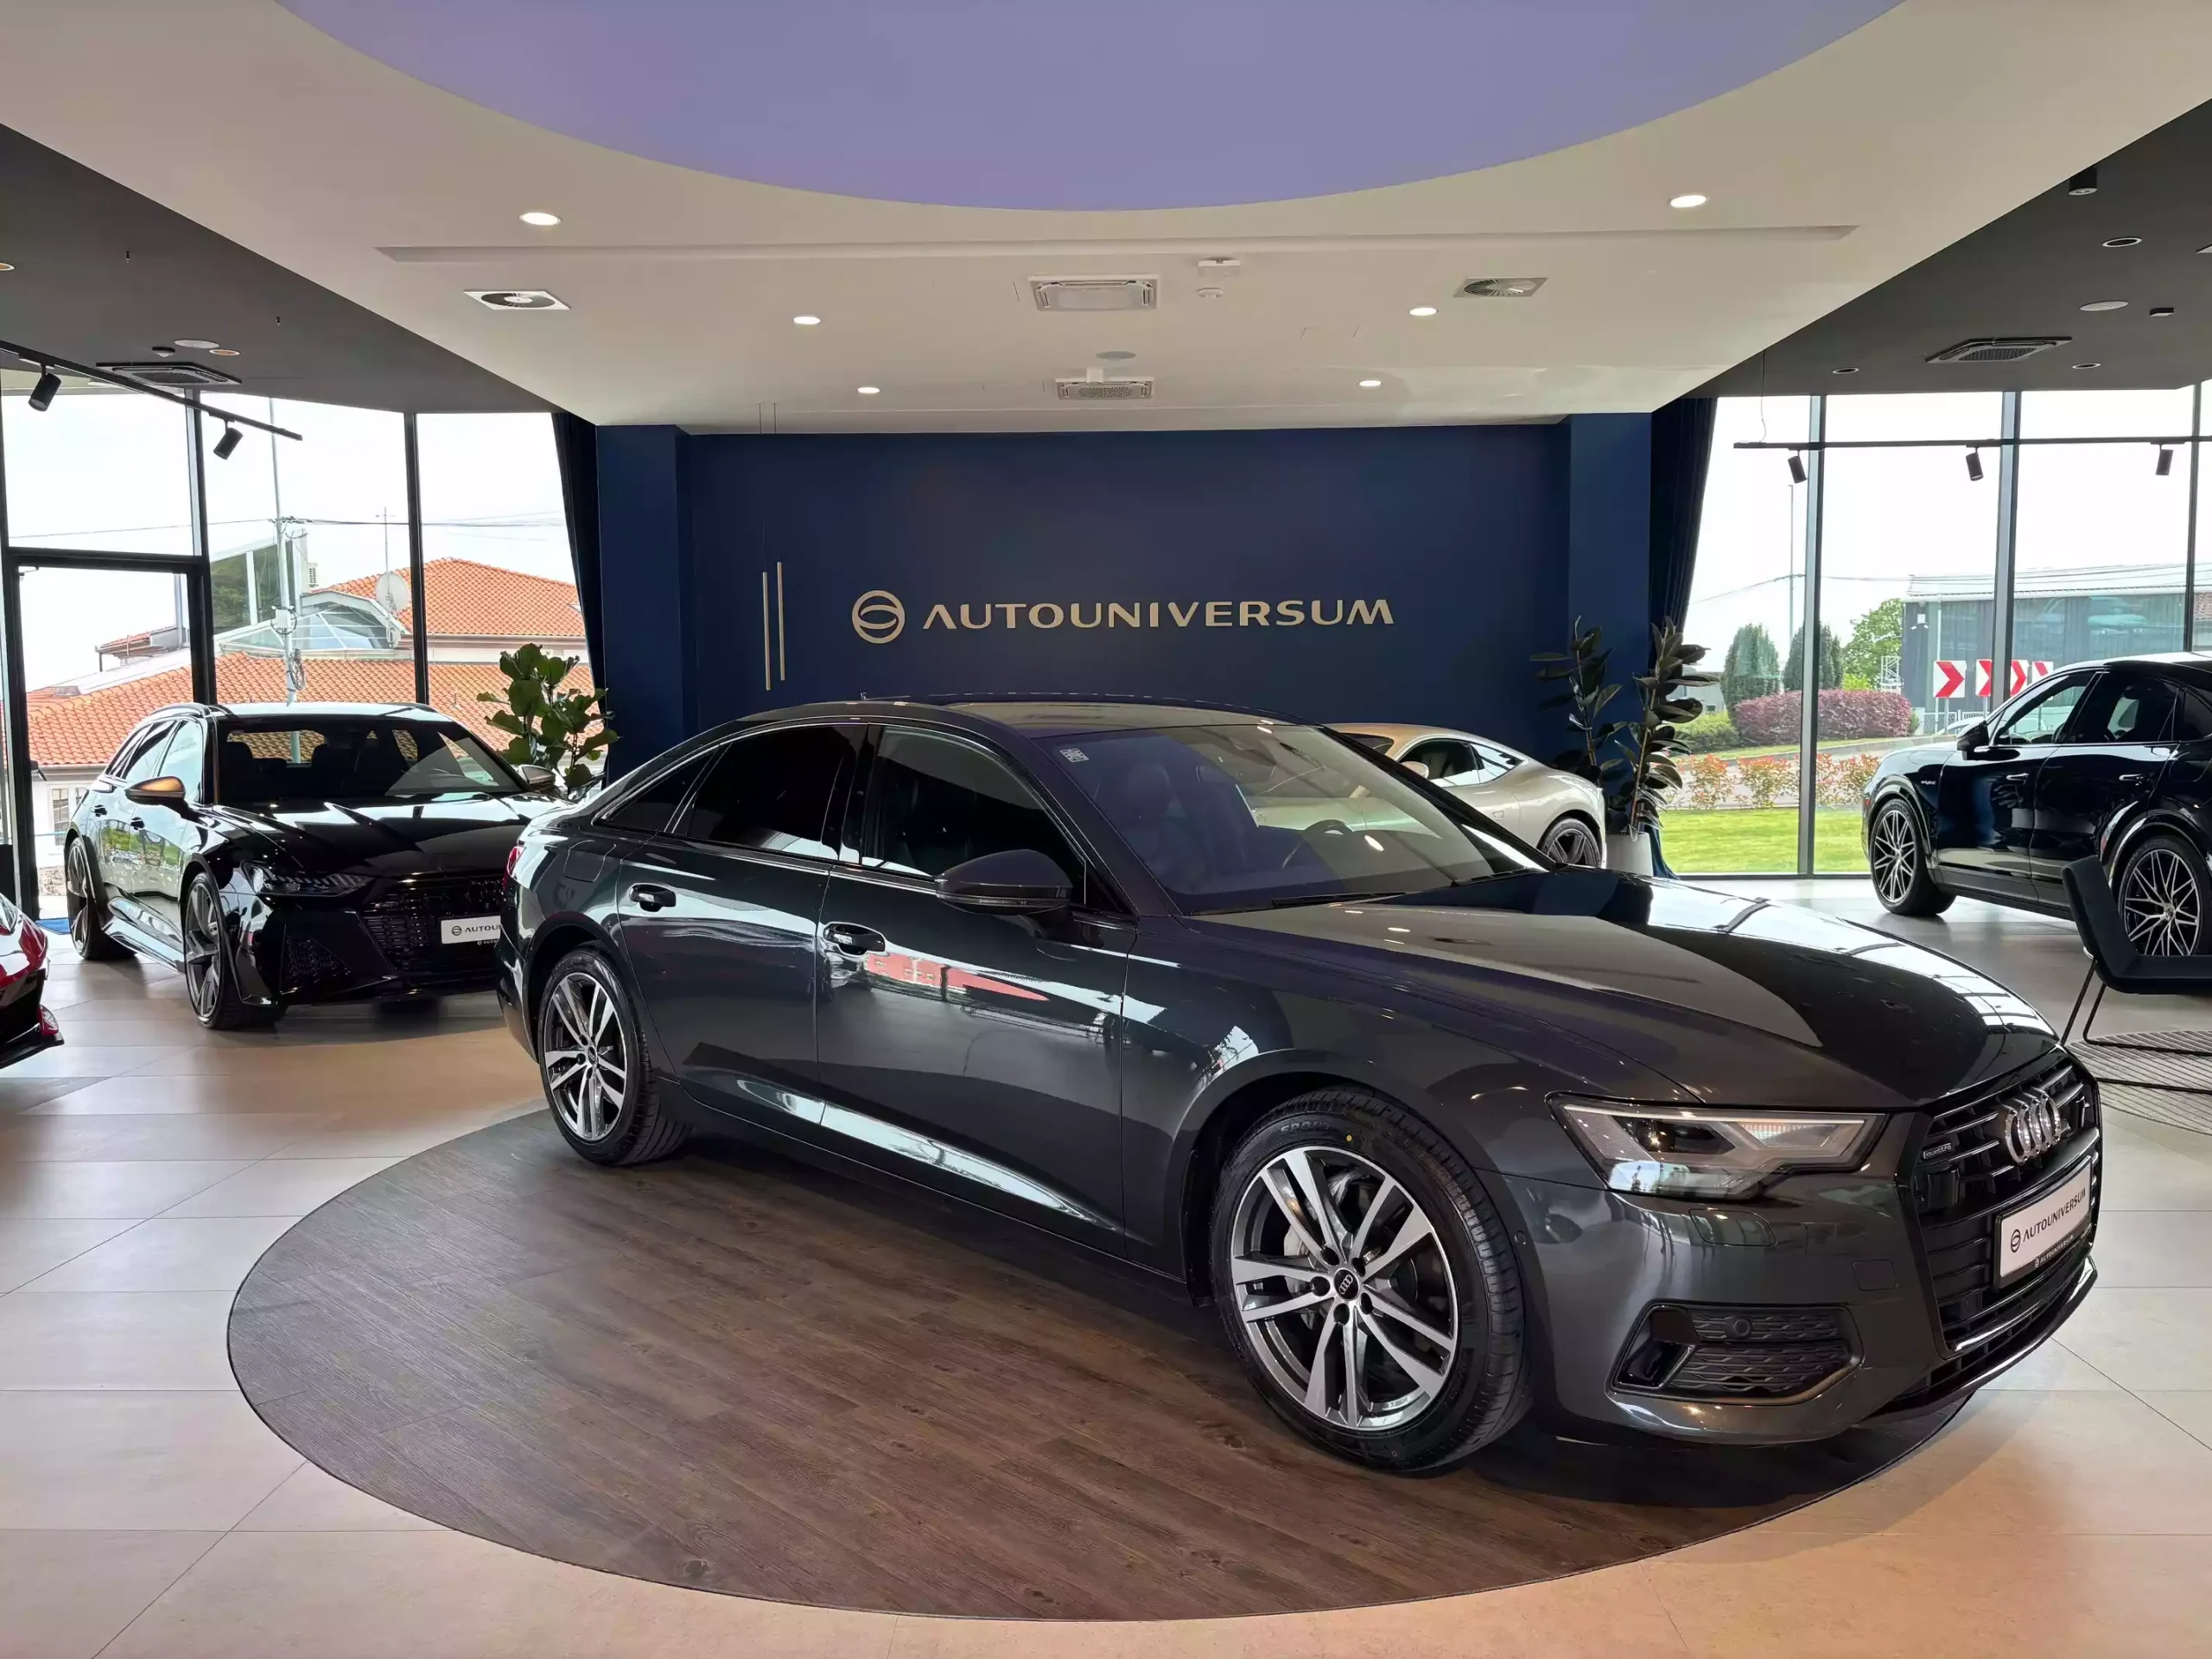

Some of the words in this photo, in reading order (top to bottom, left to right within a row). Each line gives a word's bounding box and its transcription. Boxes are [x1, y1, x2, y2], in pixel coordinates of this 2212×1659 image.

[922, 599, 1395, 629] AUTOUNIVERSUM
[1925, 1145, 1952, 1159] quattro
[2023, 1187, 2086, 1243] AUTOUNIVERSUM
[2039, 1234, 2074, 1263] AUTOUNIVERSUM
